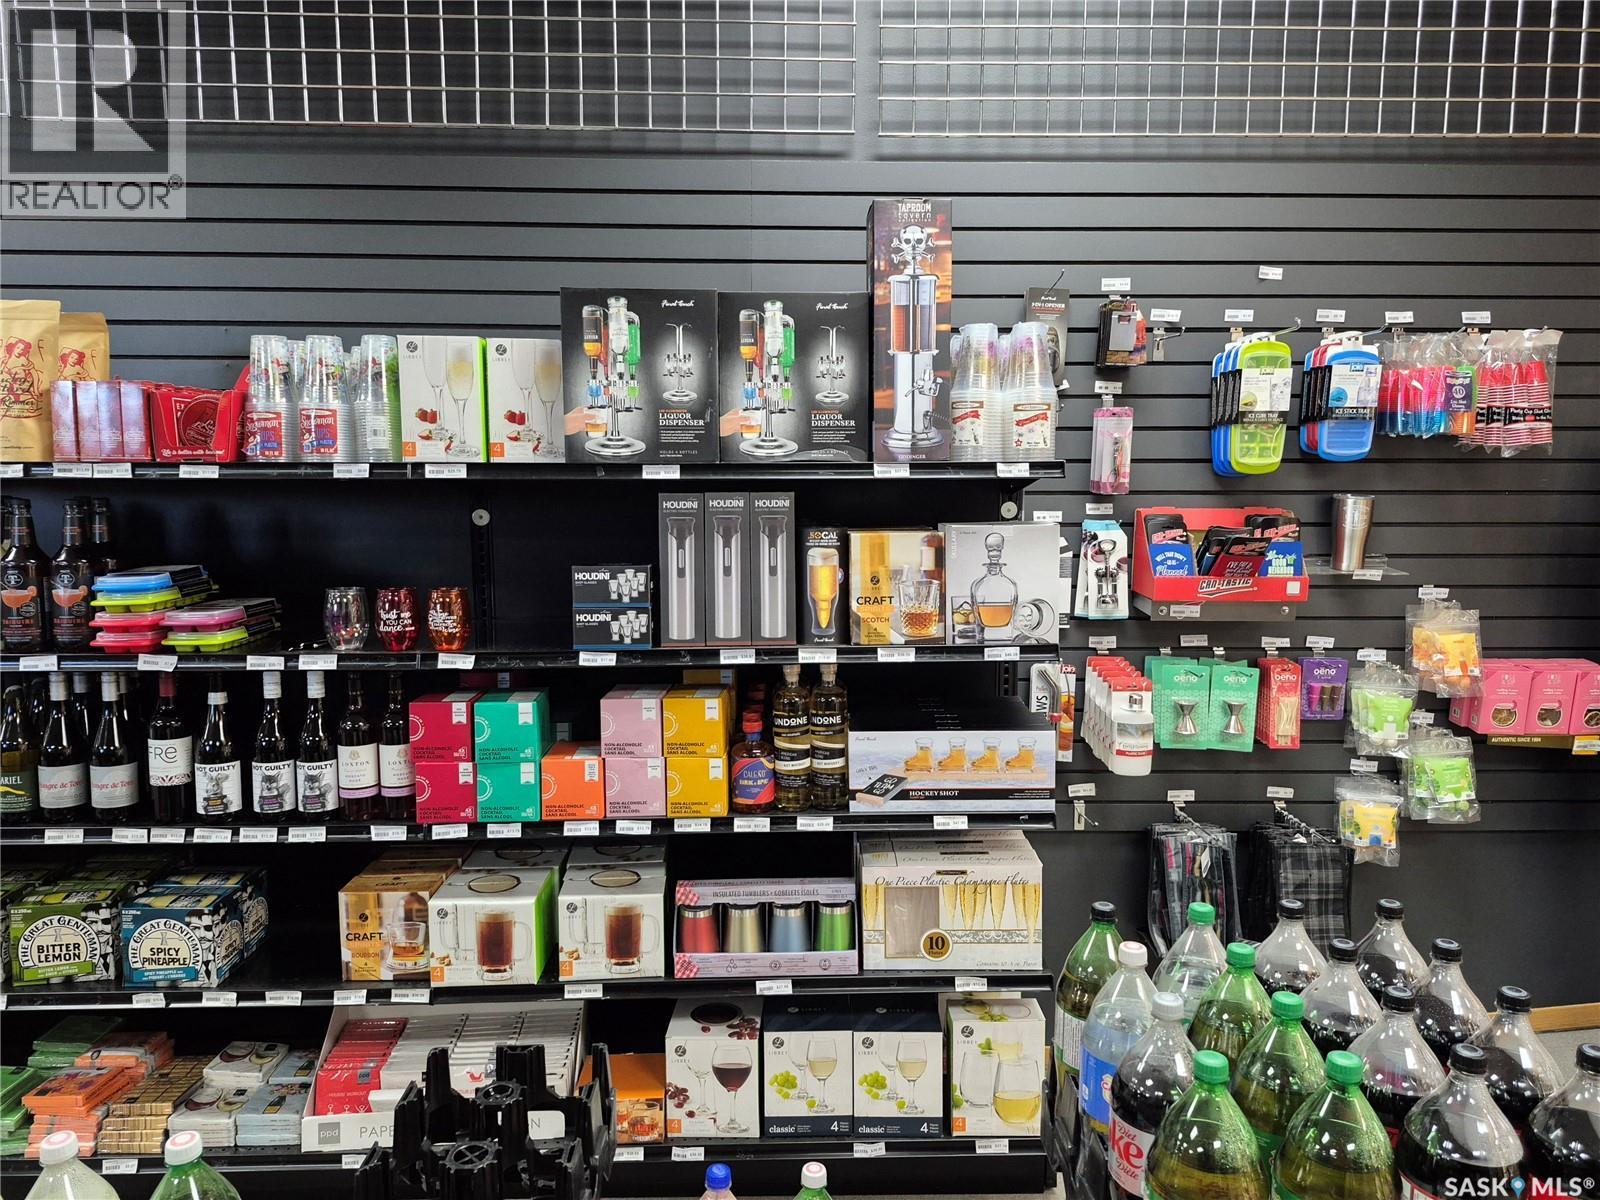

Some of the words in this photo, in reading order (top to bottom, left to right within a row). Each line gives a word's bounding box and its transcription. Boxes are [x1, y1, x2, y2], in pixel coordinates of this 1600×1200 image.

[898, 203, 931, 213] TAPROOM
[494, 443, 501, 451] 4
[663, 501, 698, 509] HOUDINI
[808, 531, 838, 539] SOCAL
[575, 572, 610, 580] HOUDINI
[1199, 579, 1253, 591] CAN-TASTIC
[856, 596, 894, 605] CRAFT
[813, 715, 842, 724] NDONE
[208, 763, 237, 773] GUILTY
[264, 763, 291, 772] GUILTY
[306, 762, 334, 771] GUILTY
[875, 876, 894, 886] One
[895, 876, 918, 886] Piece
[919, 872, 950, 886] Plastic
[953, 870, 1001, 894] Champagne
[1002, 872, 1029, 886] Flutes
[23, 918, 55, 942] GREAT
[132, 921, 161, 943] GREAT
[57, 916, 98, 960] GENTLEMAN
[346, 932, 384, 941] CRAFT
[164, 919, 200, 966] GENTLEMAN
[928, 936, 945, 950] 10
[37, 943, 81, 954] BITTER
[149, 947, 181, 957] SPICY
[21, 944, 29, 965] THE
[37, 952, 81, 963] LEMON
[130, 944, 139, 965] THE
[142, 957, 188, 966] PINEAPPLE
[561, 962, 569, 971] 4
[433, 969, 441, 977] 4
[358, 1072, 370, 1080] ppd
[671, 1120, 679, 1129] 4
[830, 1121, 839, 1132] 4
[955, 1118, 963, 1127] 4
[769, 1125, 796, 1133] classic
[858, 1125, 885, 1134] classic
[920, 1122, 929, 1133] 4
[320, 1128, 338, 1137] ppd
[1119, 1123, 1137, 1142] Diet
